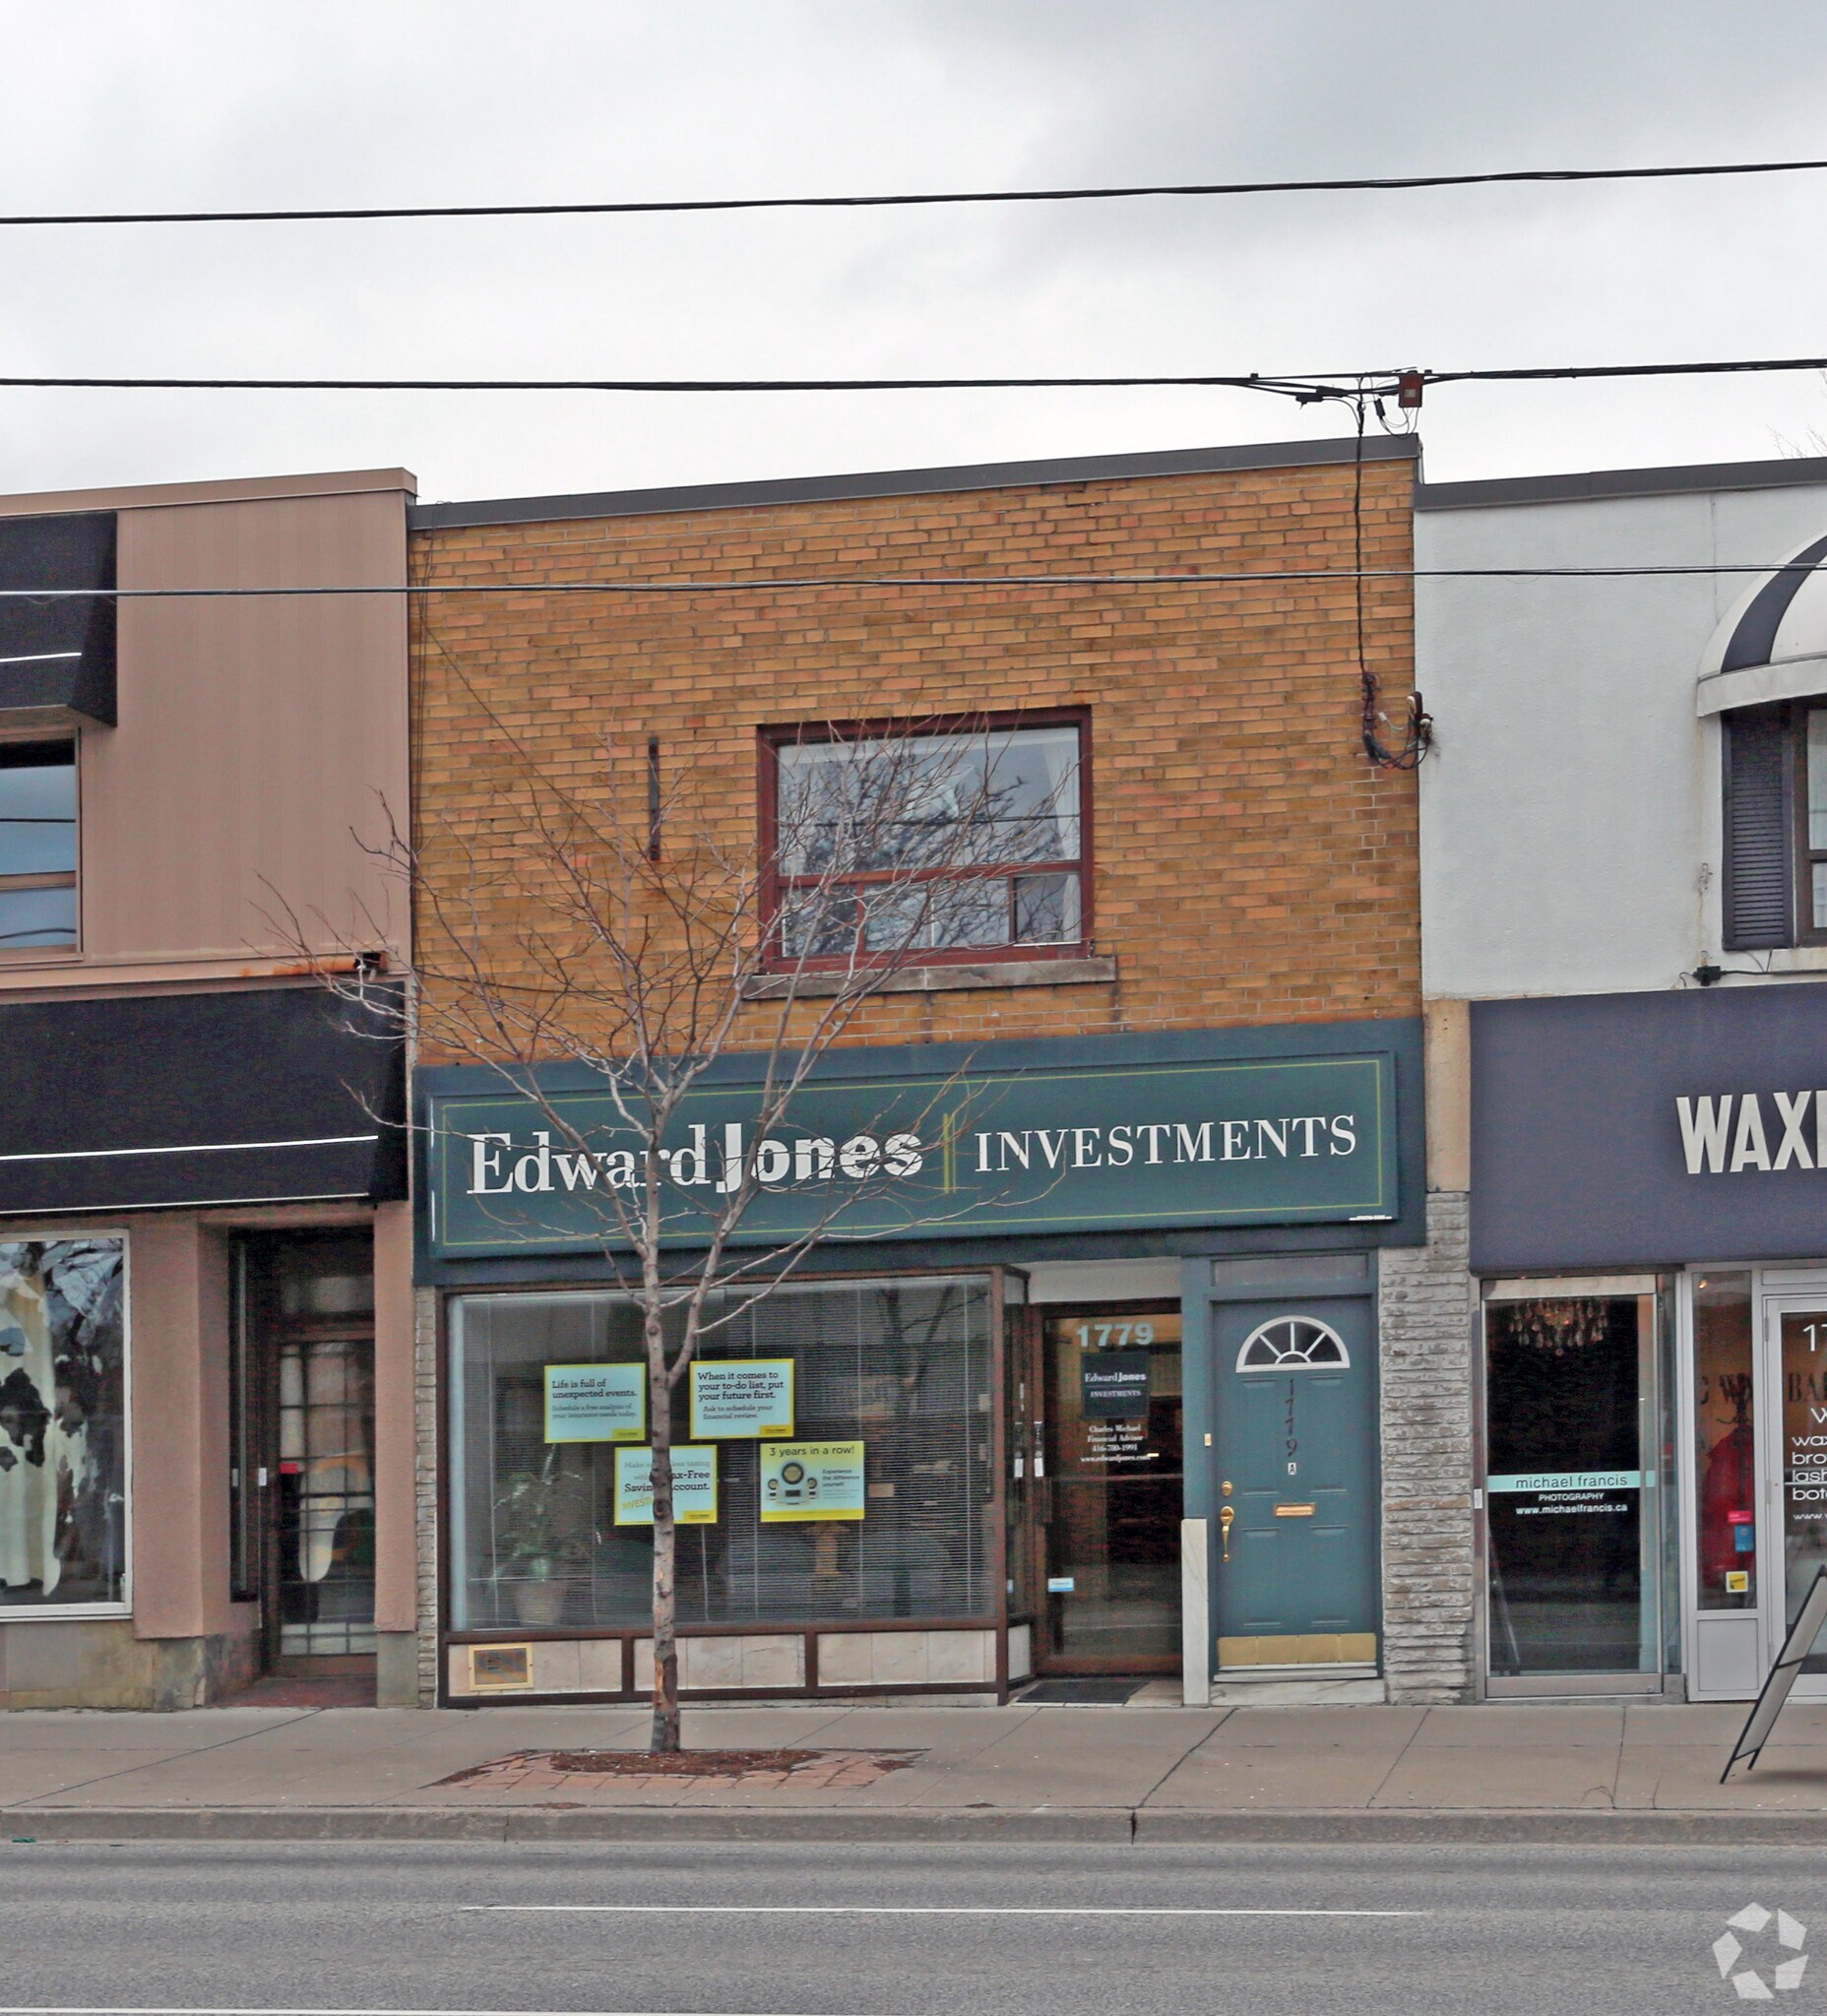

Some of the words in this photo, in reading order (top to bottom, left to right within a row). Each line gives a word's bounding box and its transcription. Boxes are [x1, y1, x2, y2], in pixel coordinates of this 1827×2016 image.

[975, 1114, 1356, 1172] INVESTMENTS
[1076, 1323, 1154, 1348] 1779
[698, 1371, 725, 1380] When
[552, 1380, 569, 1389] Life
[580, 1379, 595, 1388] full
[597, 1378, 606, 1387] of
[723, 1381, 747, 1390] to-do
[748, 1380, 766, 1389] list,
[768, 1381, 786, 1390] put
[552, 1389, 603, 1400] unexpected
[722, 1391, 752, 1400] future
[753, 1390, 776, 1399] first.
[770, 1447, 776, 1456] 3
[780, 1447, 806, 1457] years
[810, 1446, 819, 1455] in
[832, 1445, 854, 1454] row!
[671, 1470, 711, 1479] ax-Free
[1516, 1476, 1573, 1488] michael
[1578, 1475, 1628, 1486] francis
[625, 1483, 653, 1492] Savin
[1538, 1492, 1605, 1501] PHOTOGRAPHY
[1515, 1503, 1628, 1515] www.michaelfrancis.ca
